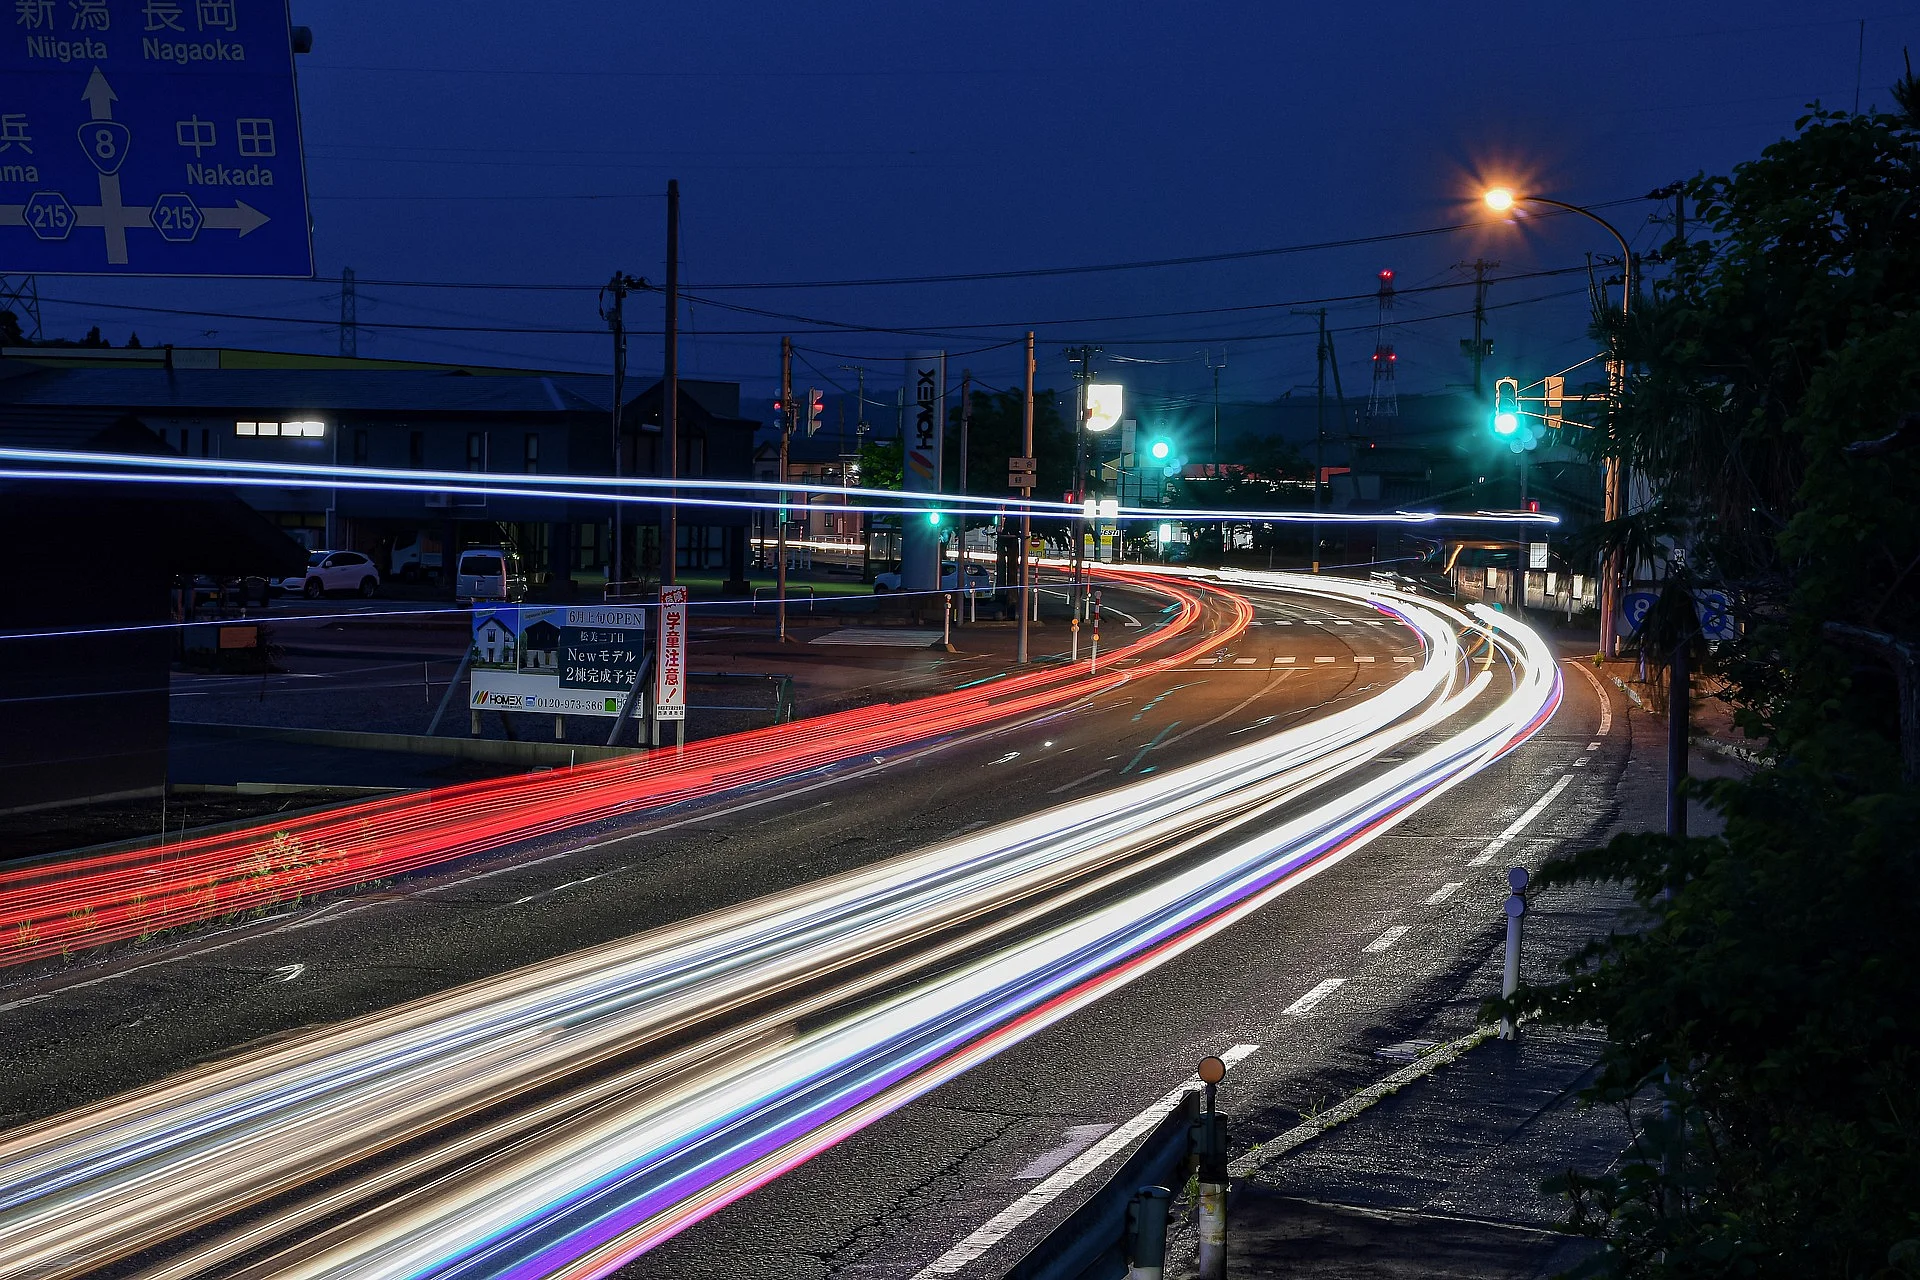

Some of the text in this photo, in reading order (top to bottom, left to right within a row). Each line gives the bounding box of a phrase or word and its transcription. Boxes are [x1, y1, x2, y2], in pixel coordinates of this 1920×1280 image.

[16, 0, 238, 32] 新潟 長岡
[27, 36, 245, 65] Niigata Nagaoka
[95, 129, 116, 158] 8
[176, 114, 276, 158] 中田
[186, 163, 274, 186] Nakada
[33, 205, 68, 228] 215
[160, 206, 194, 230] 215
[916, 368, 935, 450] HOMEX
[567, 647, 637, 663] Newモデル
[565, 666, 637, 685] 2棟完成予定
[489, 694, 522, 706] HOMEX
